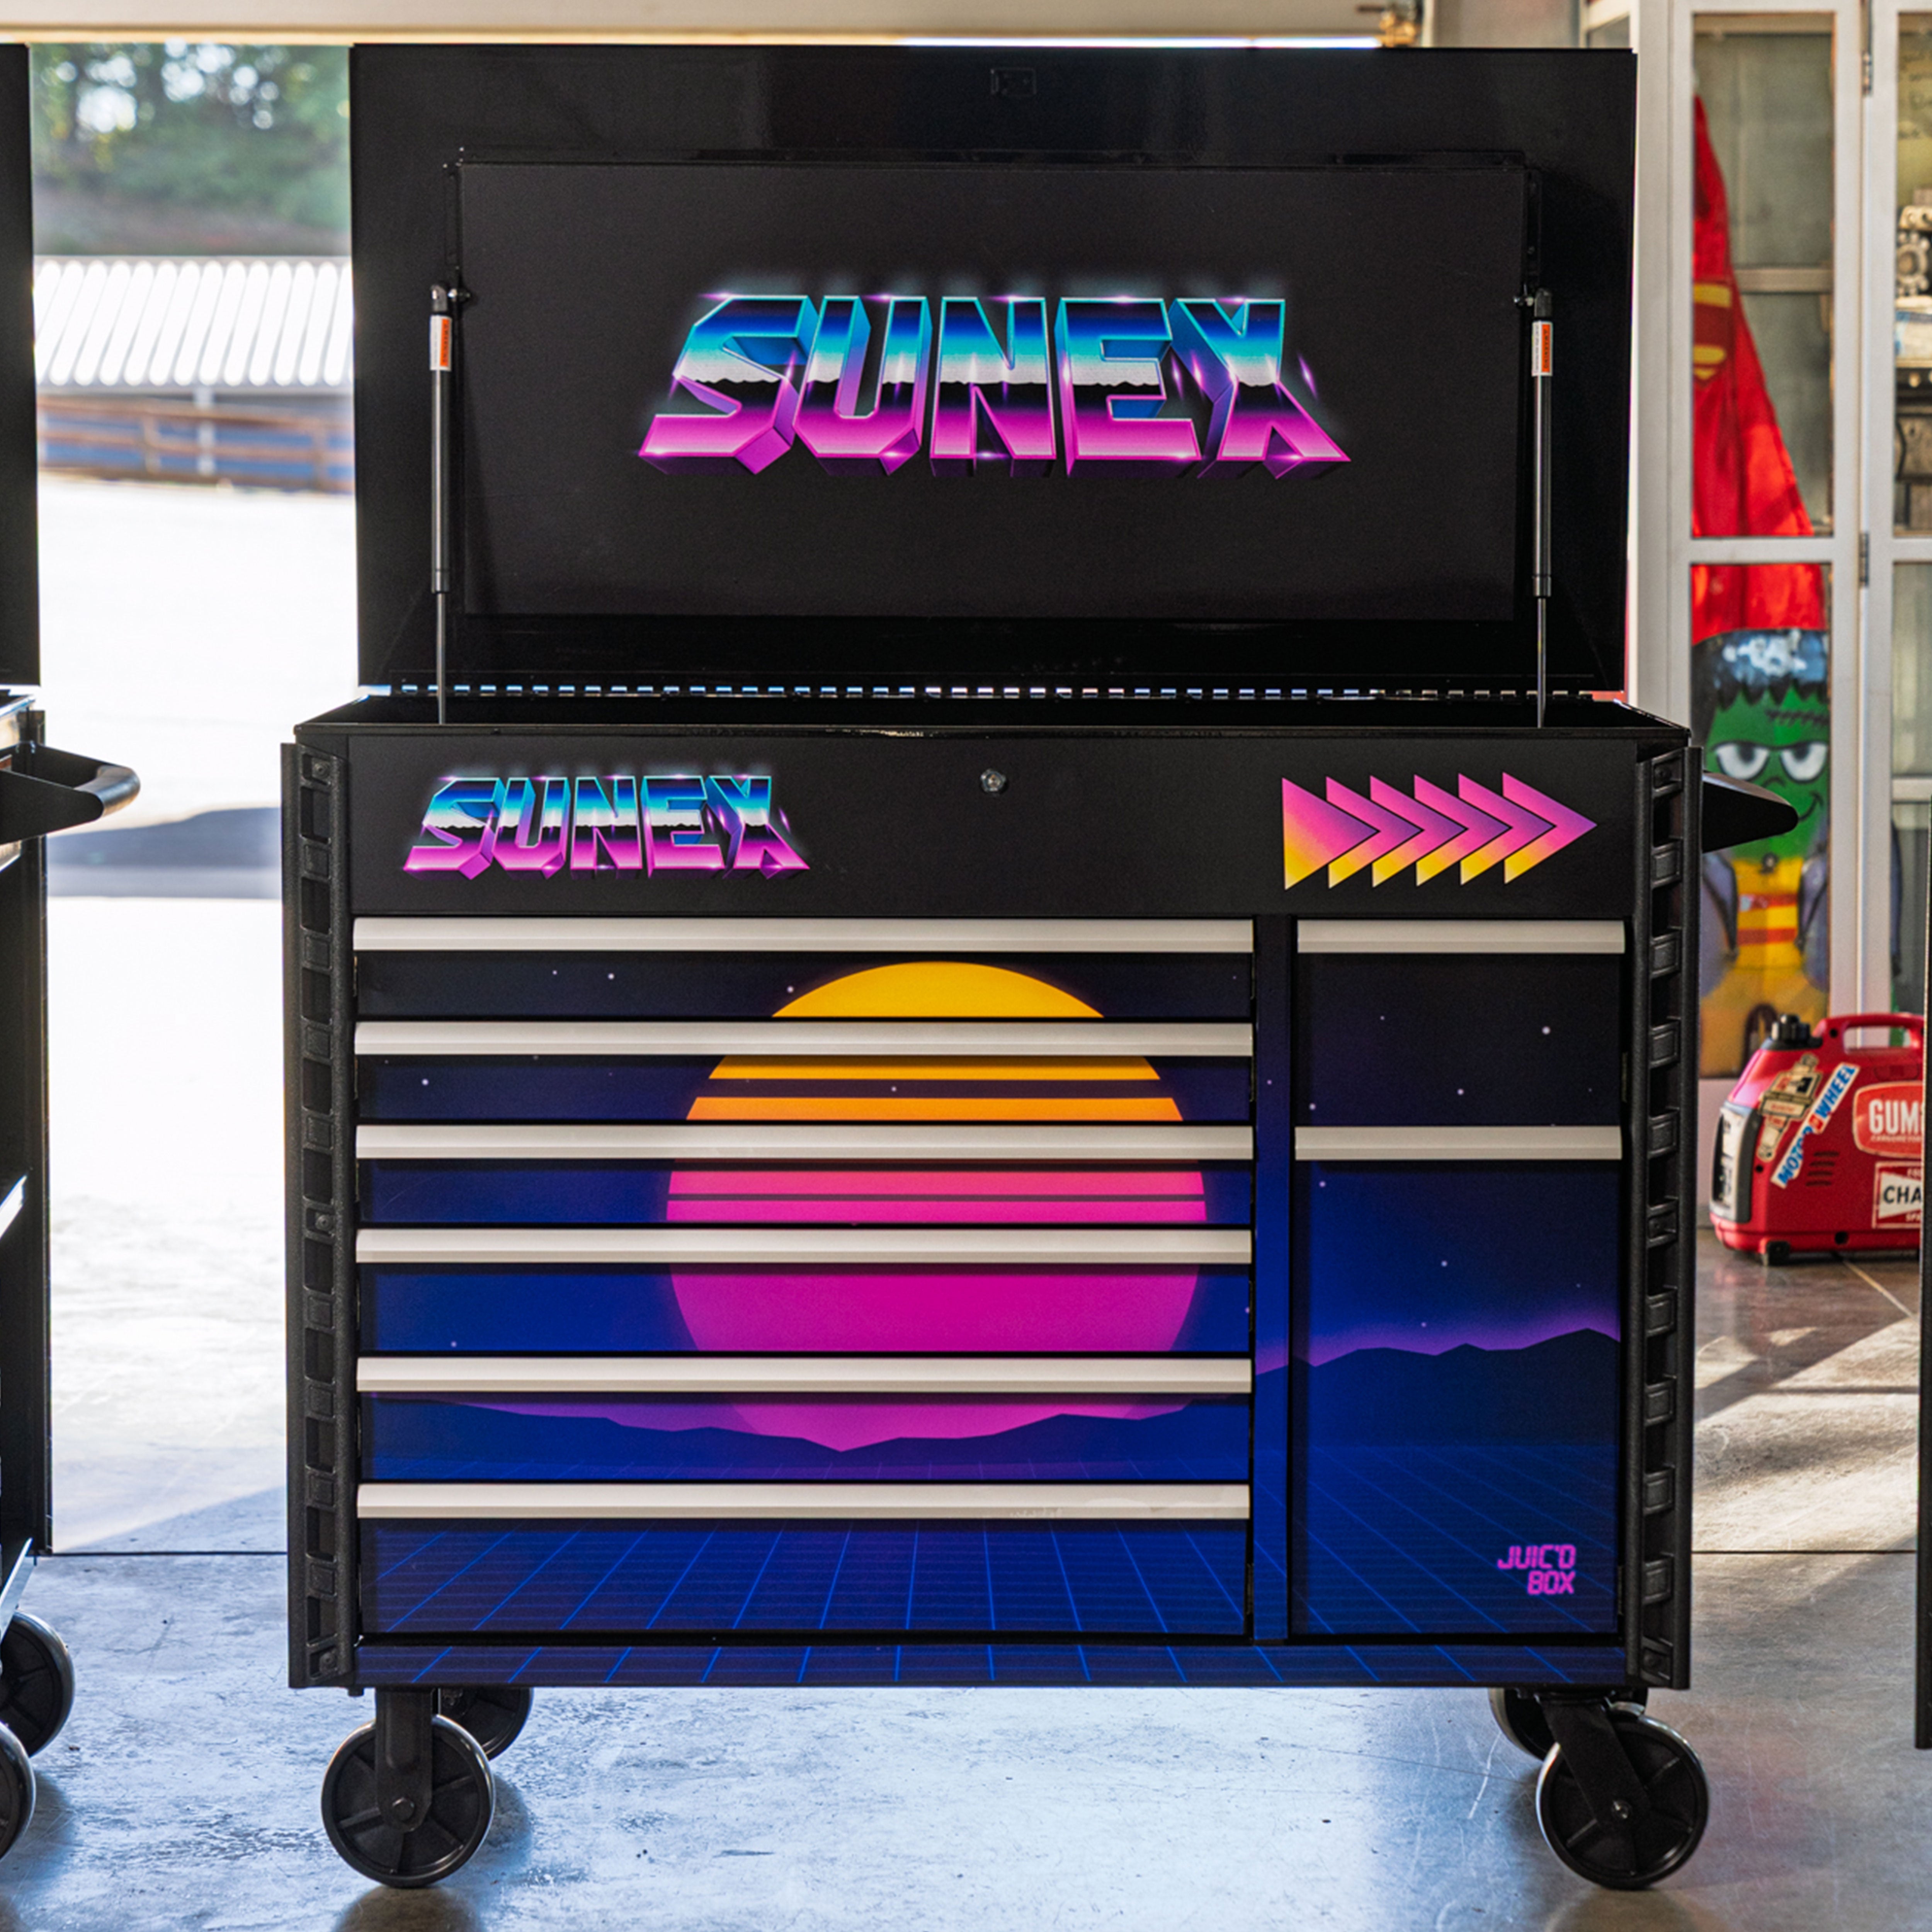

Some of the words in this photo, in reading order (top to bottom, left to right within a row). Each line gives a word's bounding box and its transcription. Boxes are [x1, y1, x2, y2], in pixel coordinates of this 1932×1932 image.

[639, 294, 1351, 478] SUNEX
[403, 776, 810, 879] SUNEX
[1815, 1065, 1856, 1118] WHEEL
[1869, 1099, 1924, 1134] GUM
[1497, 1544, 1576, 1569] JUIC'D
[1527, 1570, 1575, 1595] BOX
